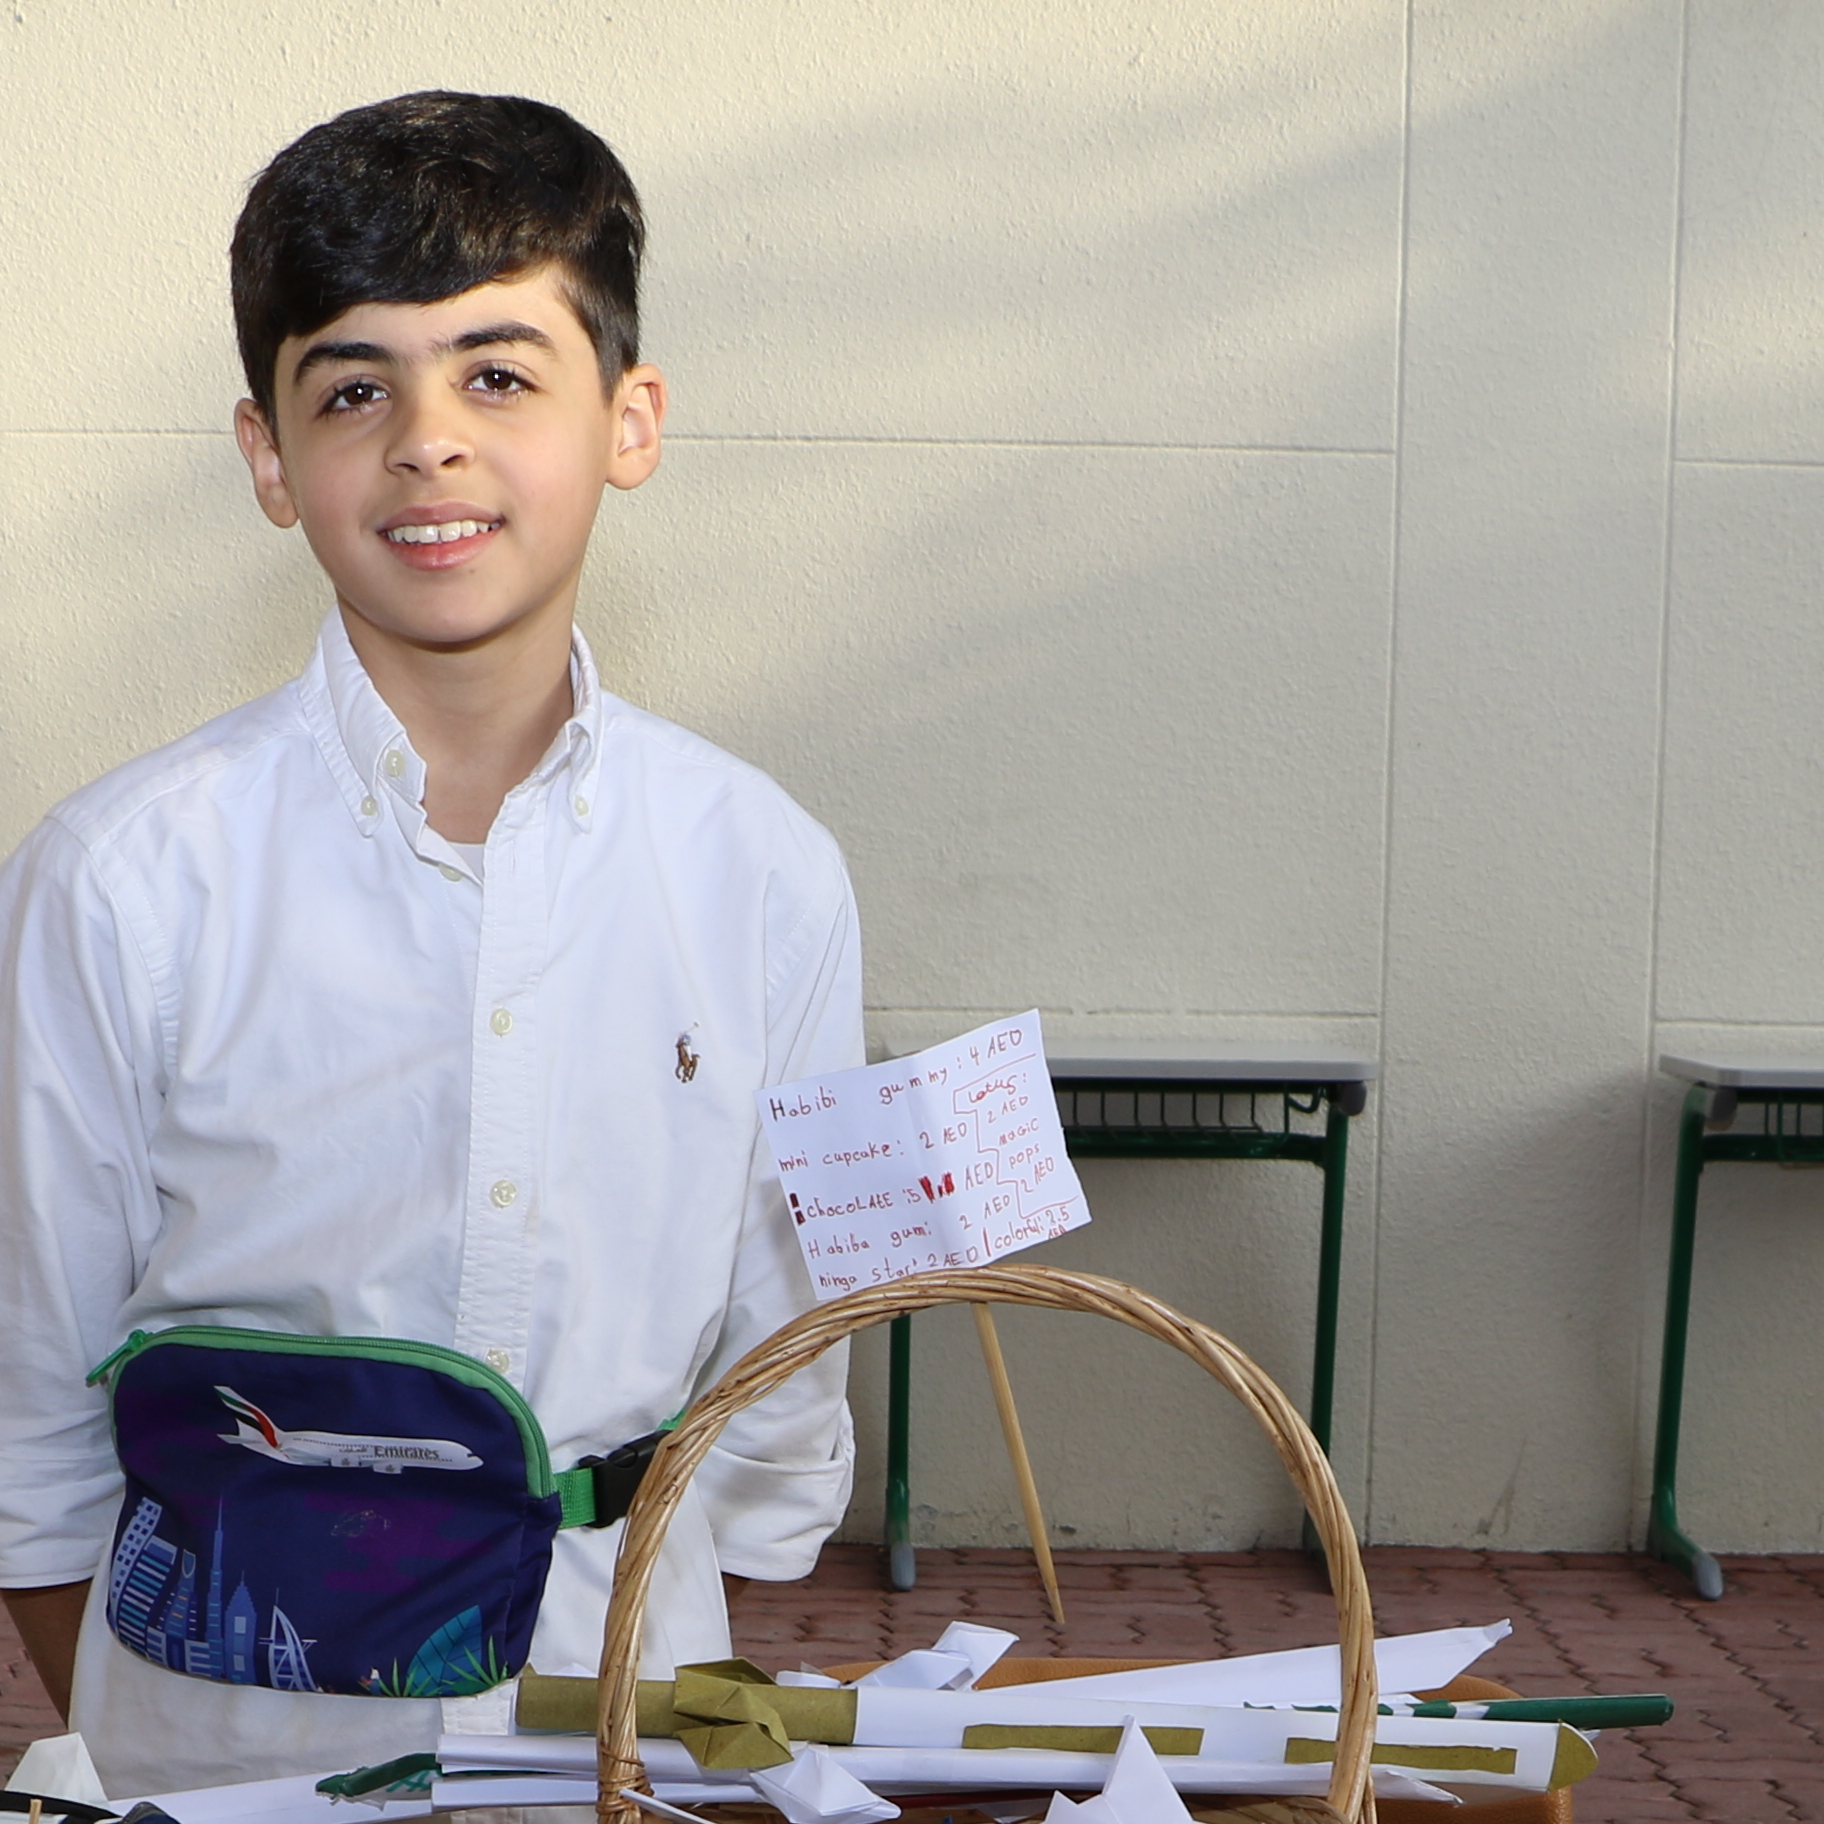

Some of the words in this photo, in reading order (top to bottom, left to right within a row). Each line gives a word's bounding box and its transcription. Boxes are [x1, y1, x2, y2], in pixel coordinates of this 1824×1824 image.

[769, 1086, 837, 1121] Habibi
[969, 1046, 980, 1066] 4
[987, 1110, 997, 1124] 2
[778, 1150, 809, 1173] mini
[919, 1131, 936, 1150] 2
[1009, 1144, 1040, 1171] pops
[807, 1233, 871, 1260] Habiba
[959, 1215, 973, 1230] 2
[927, 1254, 938, 1267] 2
[373, 1445, 440, 1460] Emirates
